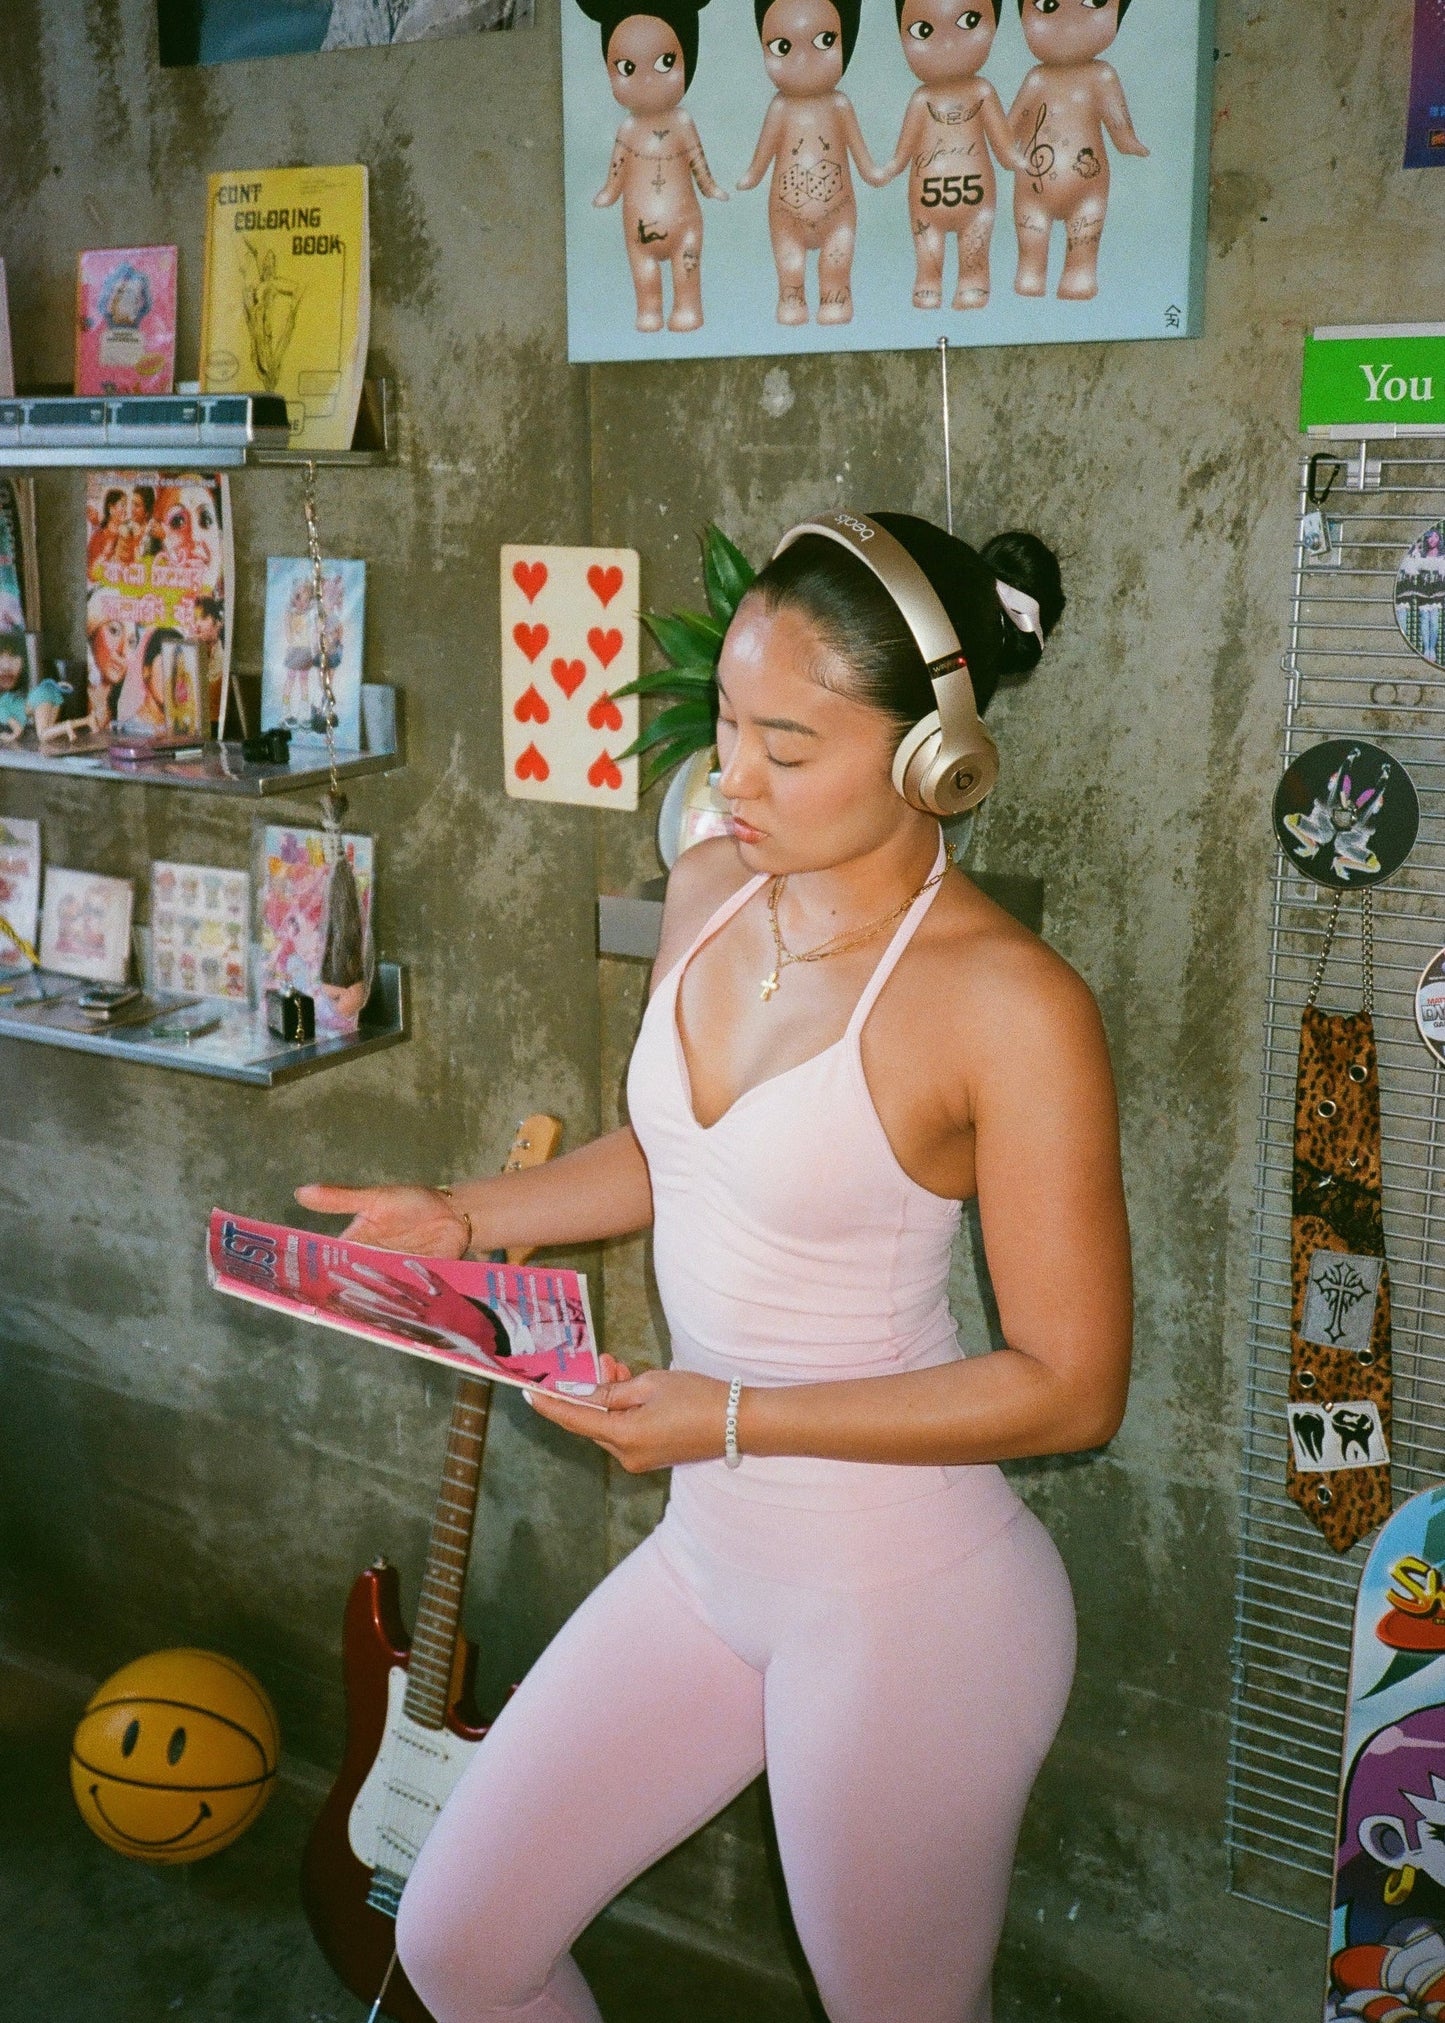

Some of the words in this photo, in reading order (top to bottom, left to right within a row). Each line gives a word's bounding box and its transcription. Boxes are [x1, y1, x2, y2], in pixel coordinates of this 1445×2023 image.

[921, 174, 985, 207] 555
[234, 207, 321, 231] COLORING
[292, 235, 341, 255] BOOK
[1359, 363, 1435, 401] You
